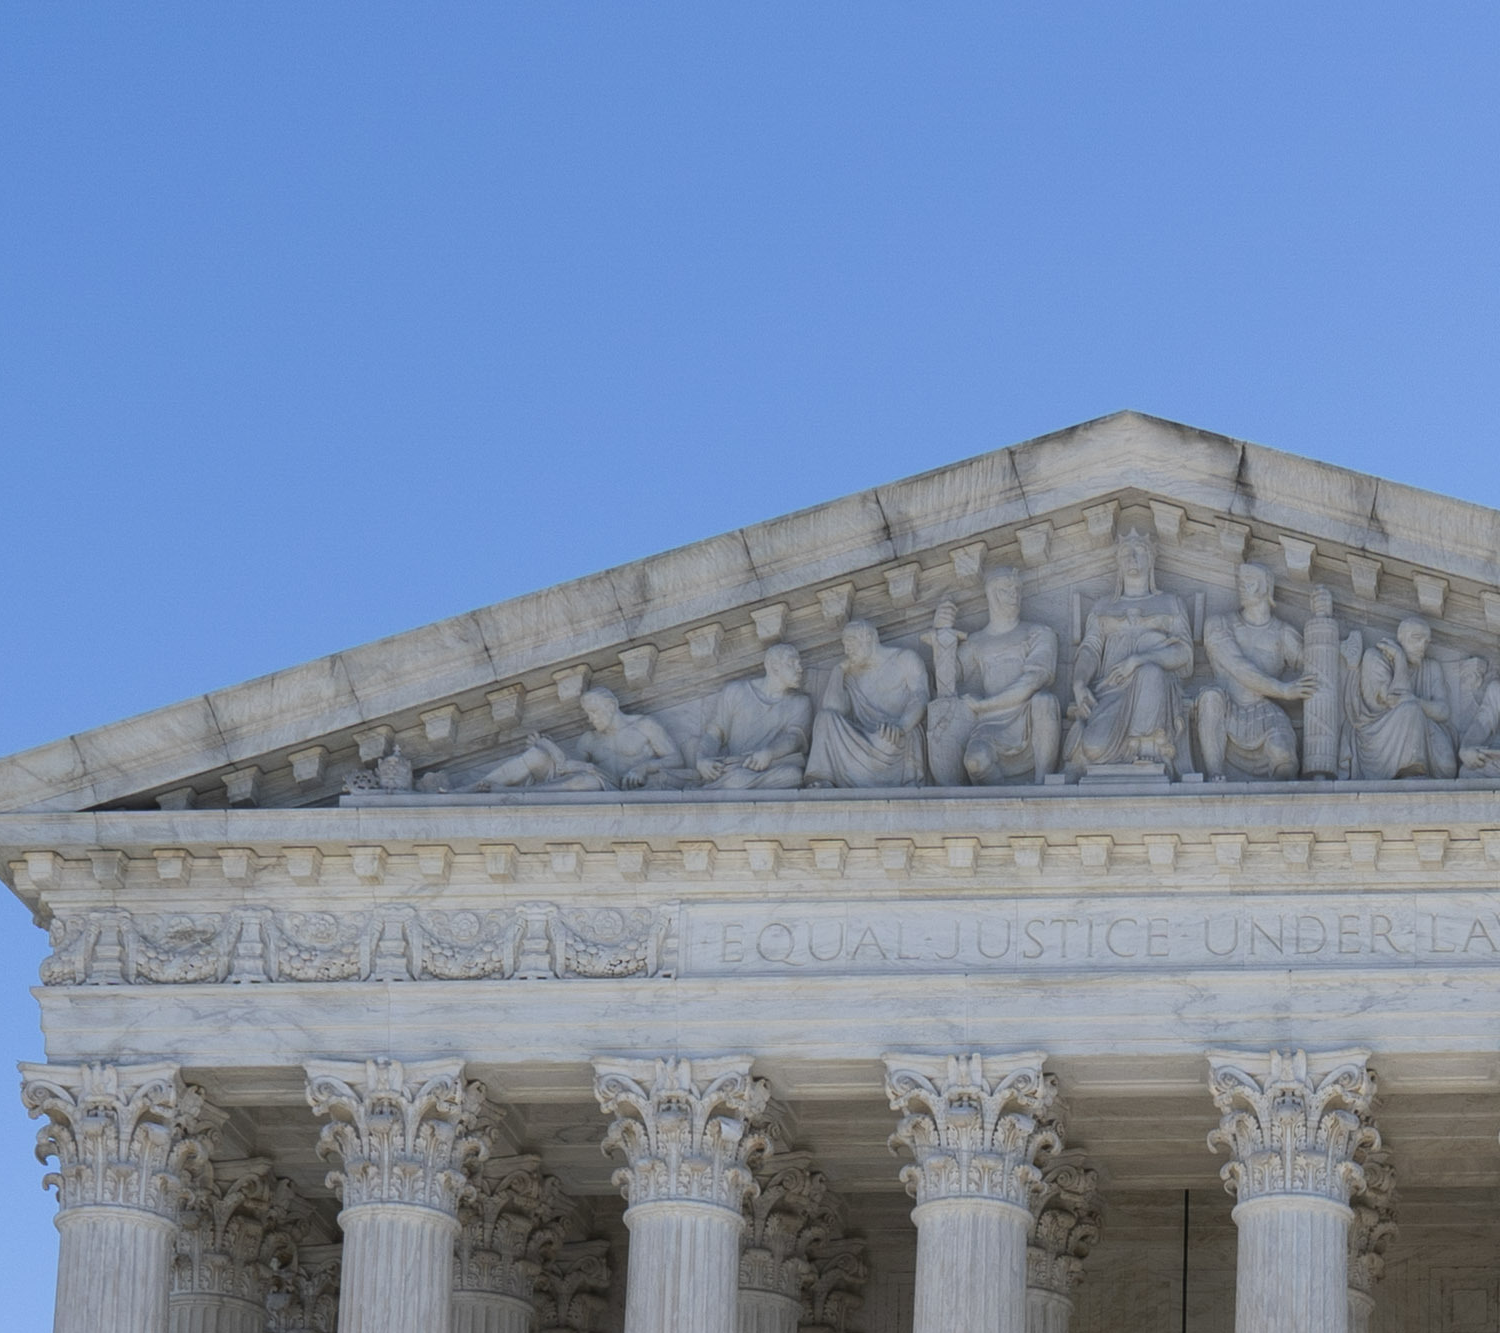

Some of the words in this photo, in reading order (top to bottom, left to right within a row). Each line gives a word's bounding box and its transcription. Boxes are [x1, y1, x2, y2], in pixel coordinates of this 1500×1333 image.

[719, 919, 922, 966] EQUAL
[933, 916, 1173, 963] JUSTICE
[1202, 912, 1402, 959] UNDER
